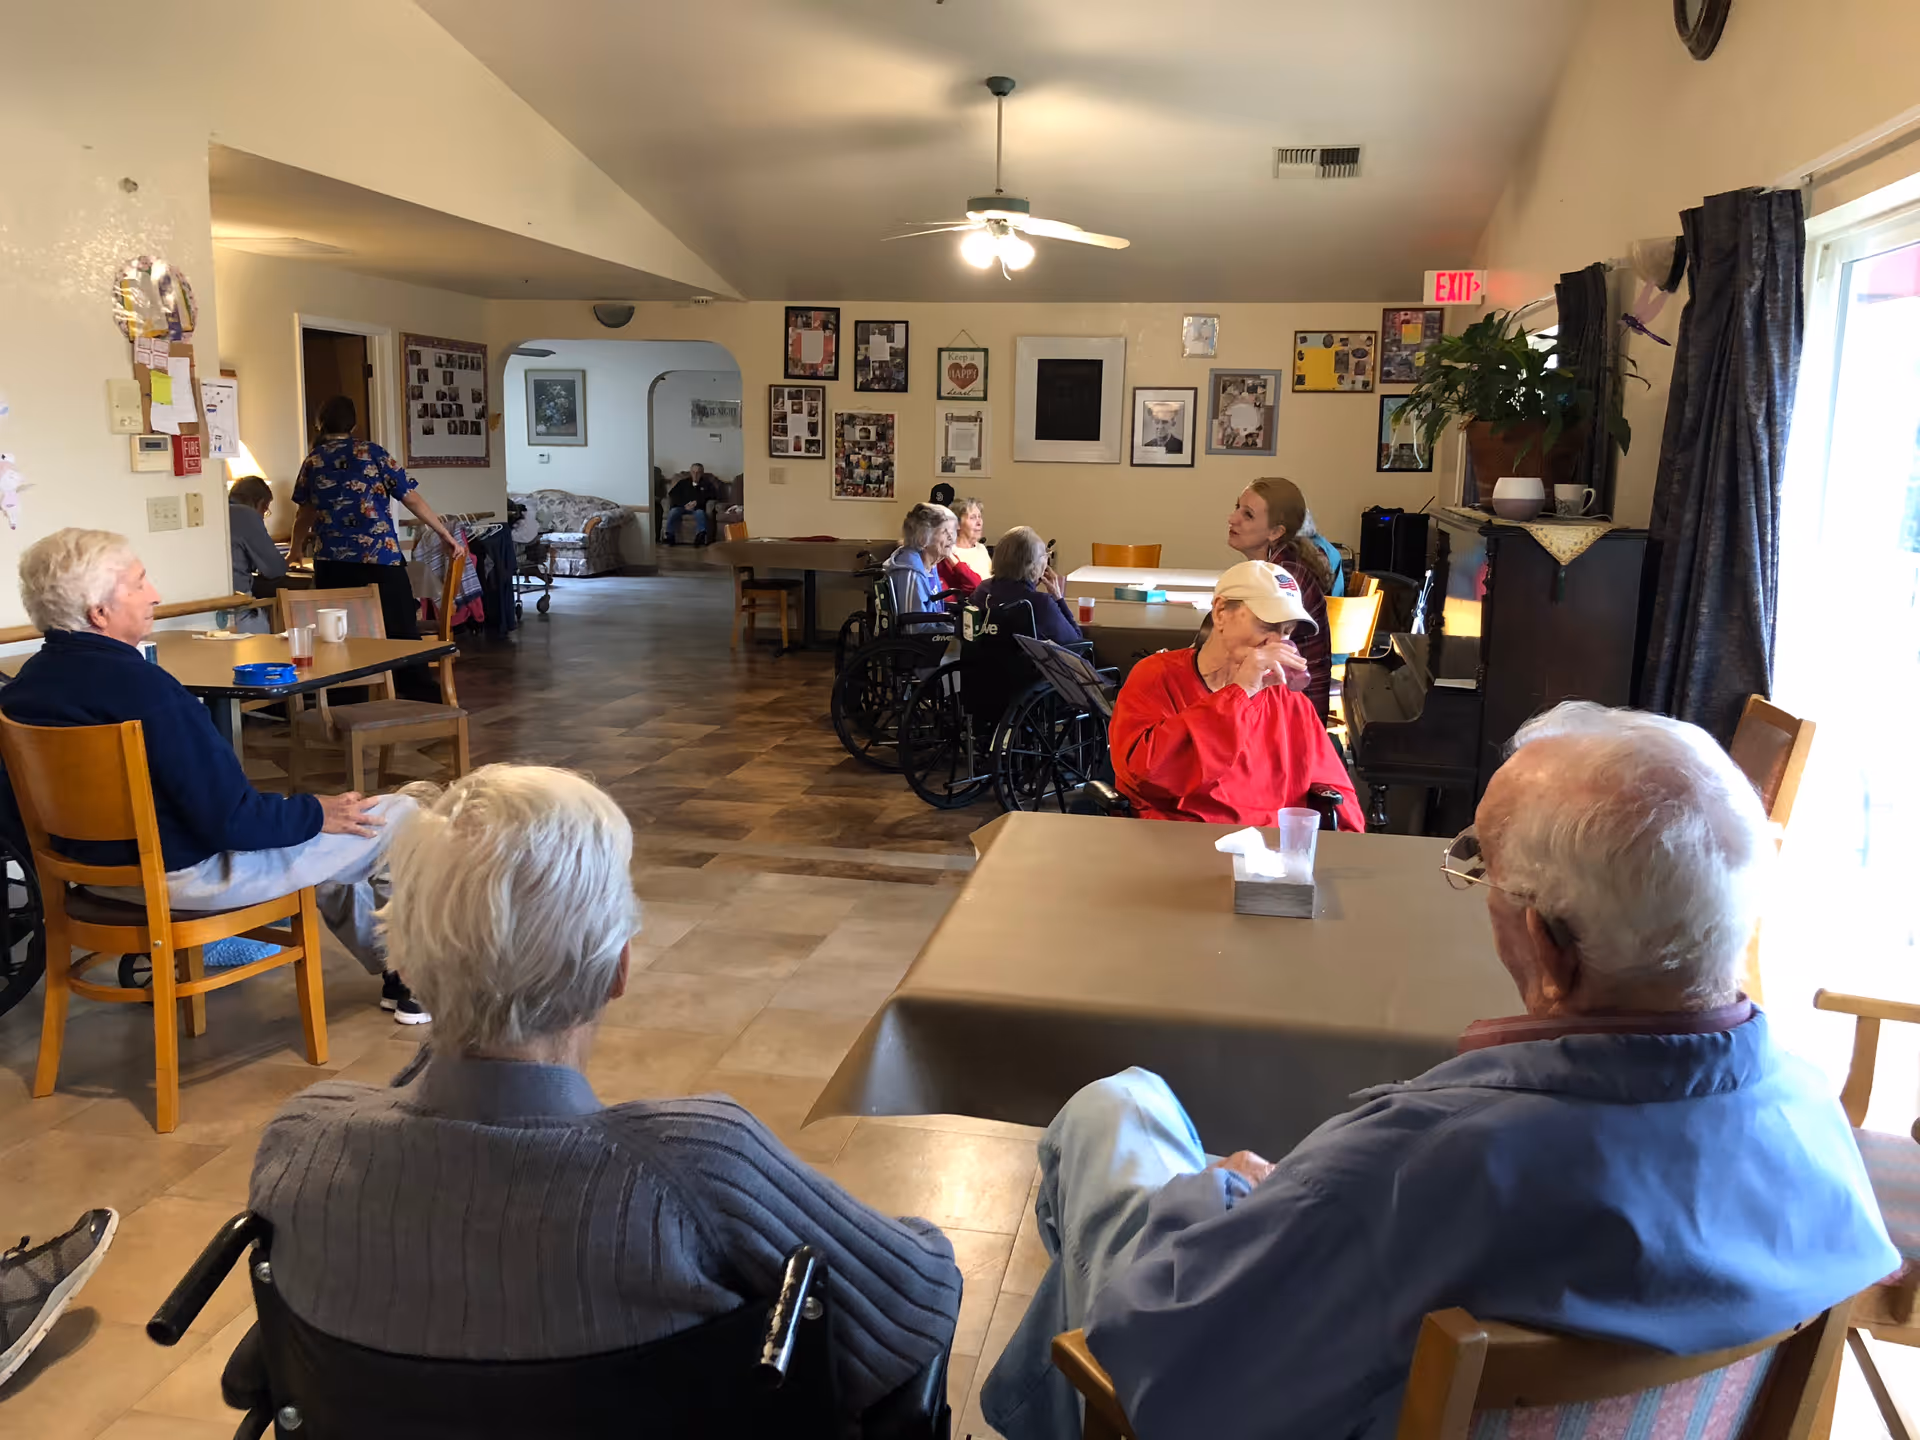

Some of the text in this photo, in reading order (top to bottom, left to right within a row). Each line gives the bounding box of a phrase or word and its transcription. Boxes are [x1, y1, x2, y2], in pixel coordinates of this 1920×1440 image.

[1435, 272, 1474, 302] EXIT
[948, 352, 968, 363] Keep
[948, 369, 977, 379] HAPPY
[946, 388, 976, 396] heart
[183, 441, 199, 456] FIRE
